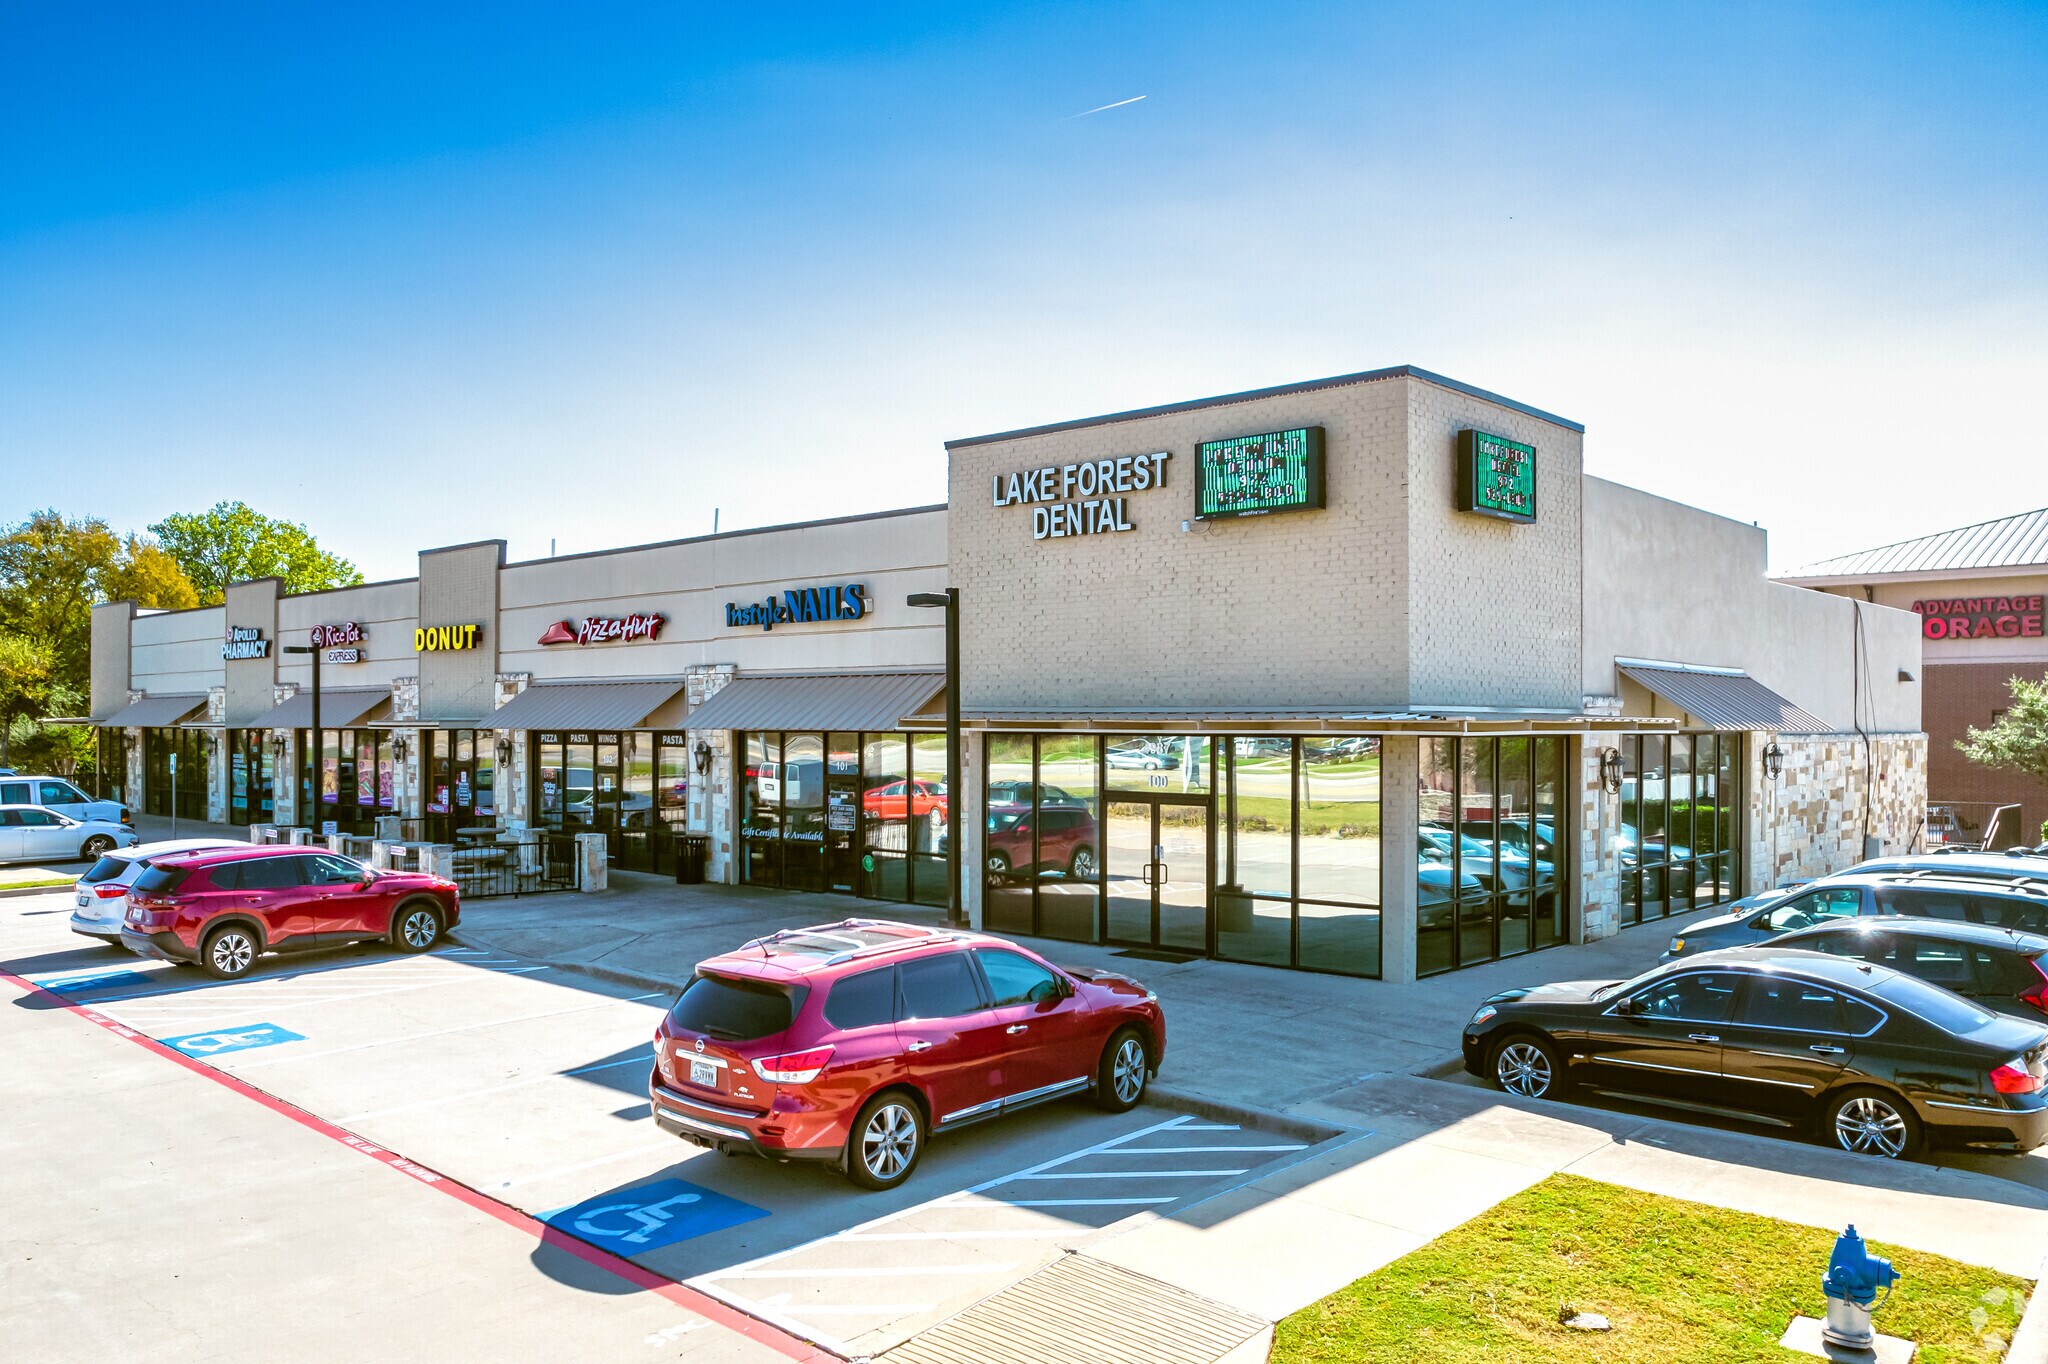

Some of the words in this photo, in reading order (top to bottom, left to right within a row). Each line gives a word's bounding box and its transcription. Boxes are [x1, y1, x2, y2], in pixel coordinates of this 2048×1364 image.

[992, 467, 1058, 507] LAKE
[1063, 451, 1170, 498] FOREST
[1033, 497, 1134, 540] DENTAL
[725, 596, 783, 631] Instyle
[784, 583, 864, 623] NAILS
[1911, 595, 2043, 615] ADVANTAGE
[325, 625, 345, 646] Rice
[346, 621, 360, 645] Pot
[1923, 615, 2043, 639] ORAGE
[415, 624, 477, 650] DONUT
[221, 640, 267, 660] PHARMACY
[328, 649, 358, 663] EXPRESS
[540, 734, 558, 743] PIZZA
[570, 734, 589, 743] PASTA
[597, 734, 617, 743] WINGS
[662, 735, 684, 745] PASTA
[603, 755, 613, 764] 102
[836, 761, 848, 771] 101
[1148, 775, 1168, 788] 100
[741, 827, 756, 838] Gift
[790, 831, 824, 841] Available
[733, 1092, 755, 1100] PLATINUM
